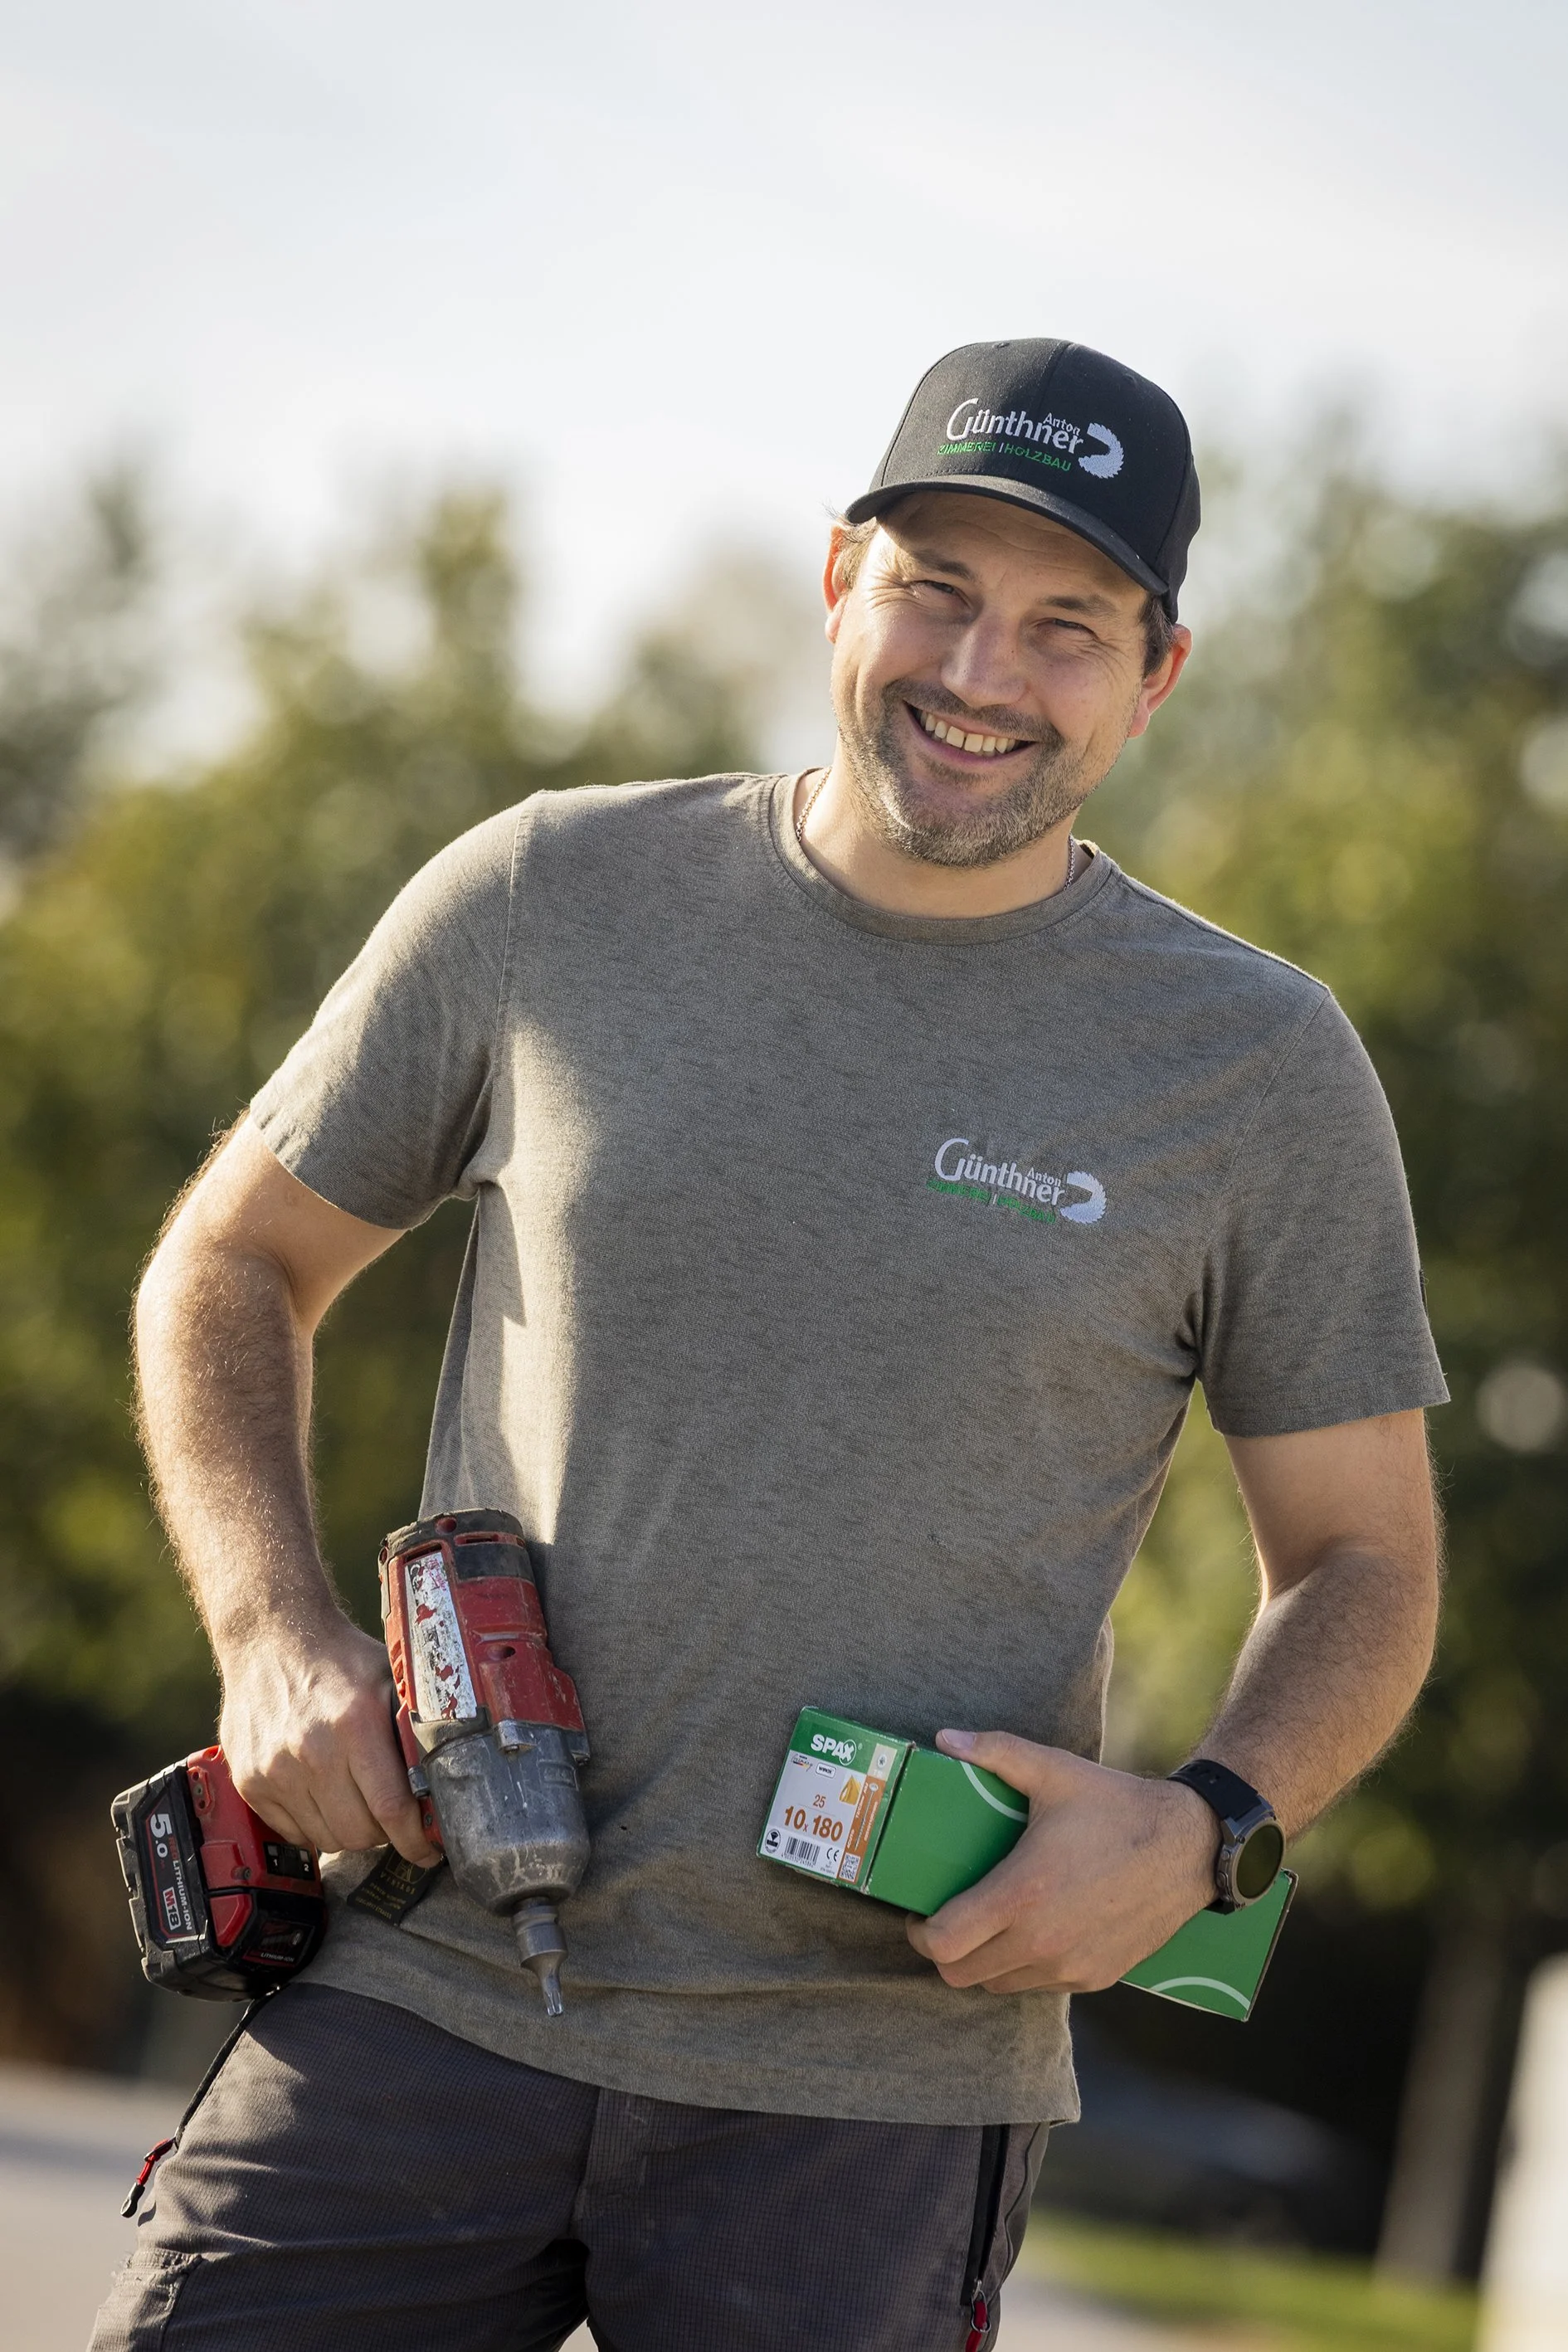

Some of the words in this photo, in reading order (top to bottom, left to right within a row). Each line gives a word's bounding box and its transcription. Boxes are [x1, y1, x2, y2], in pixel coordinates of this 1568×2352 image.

[946, 397, 1083, 454] Günthner
[1043, 412, 1081, 436] Anton
[937, 441, 996, 455] ZIMMEREI
[1005, 444, 1072, 472] HOLZBAU
[934, 1137, 1066, 1205] Günthner
[1027, 1167, 1062, 1187] Anton
[811, 1734, 856, 1765] SPAX
[813, 1794, 826, 1809] 25
[150, 1814, 173, 1858] 5.0
[813, 1814, 843, 1842] 180
[273, 1858, 278, 1867] 1
[304, 1863, 309, 1872] 2
[164, 1888, 181, 1927] M18
